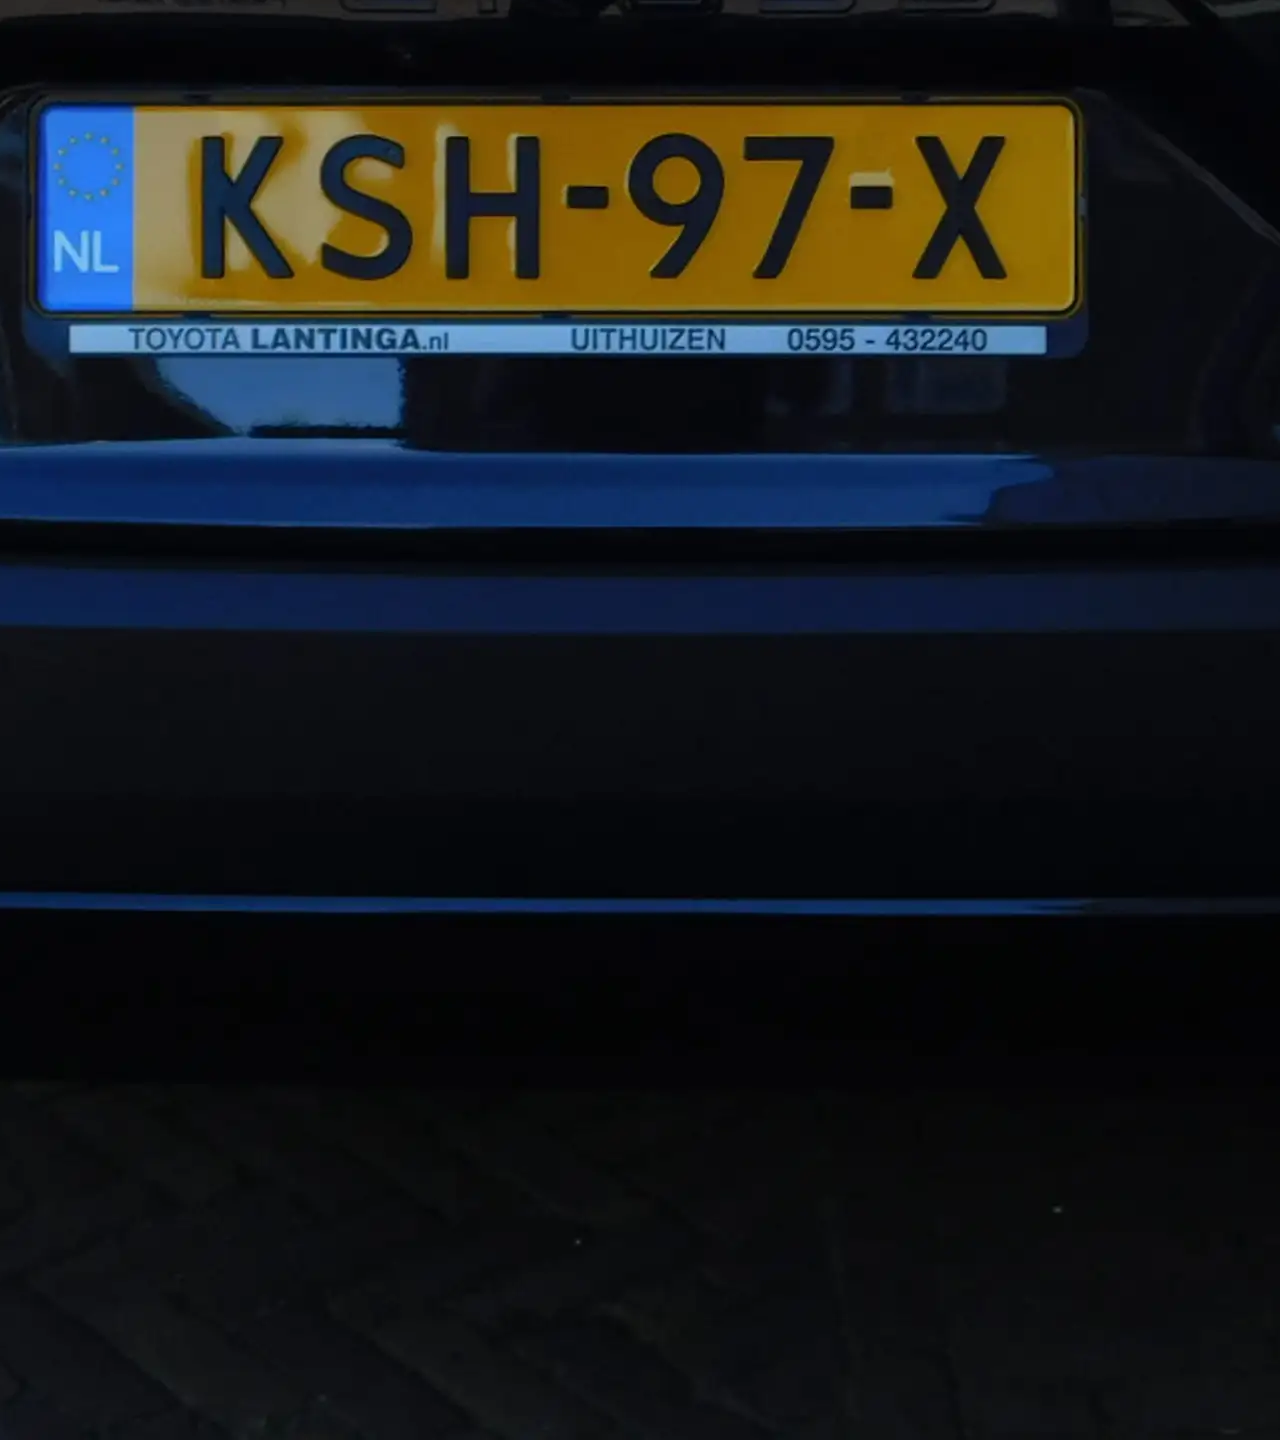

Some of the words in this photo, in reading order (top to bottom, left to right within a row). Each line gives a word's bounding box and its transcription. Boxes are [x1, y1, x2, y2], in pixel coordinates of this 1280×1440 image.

[200, 134, 1007, 281] KSH-97-X
[53, 229, 120, 273] NL
[128, 327, 242, 351] TOYOTA
[250, 327, 449, 351] LANTINGA.nl
[570, 327, 727, 352] UITHUIZEN
[786, 327, 856, 352] 0595
[884, 327, 989, 352] 432240
